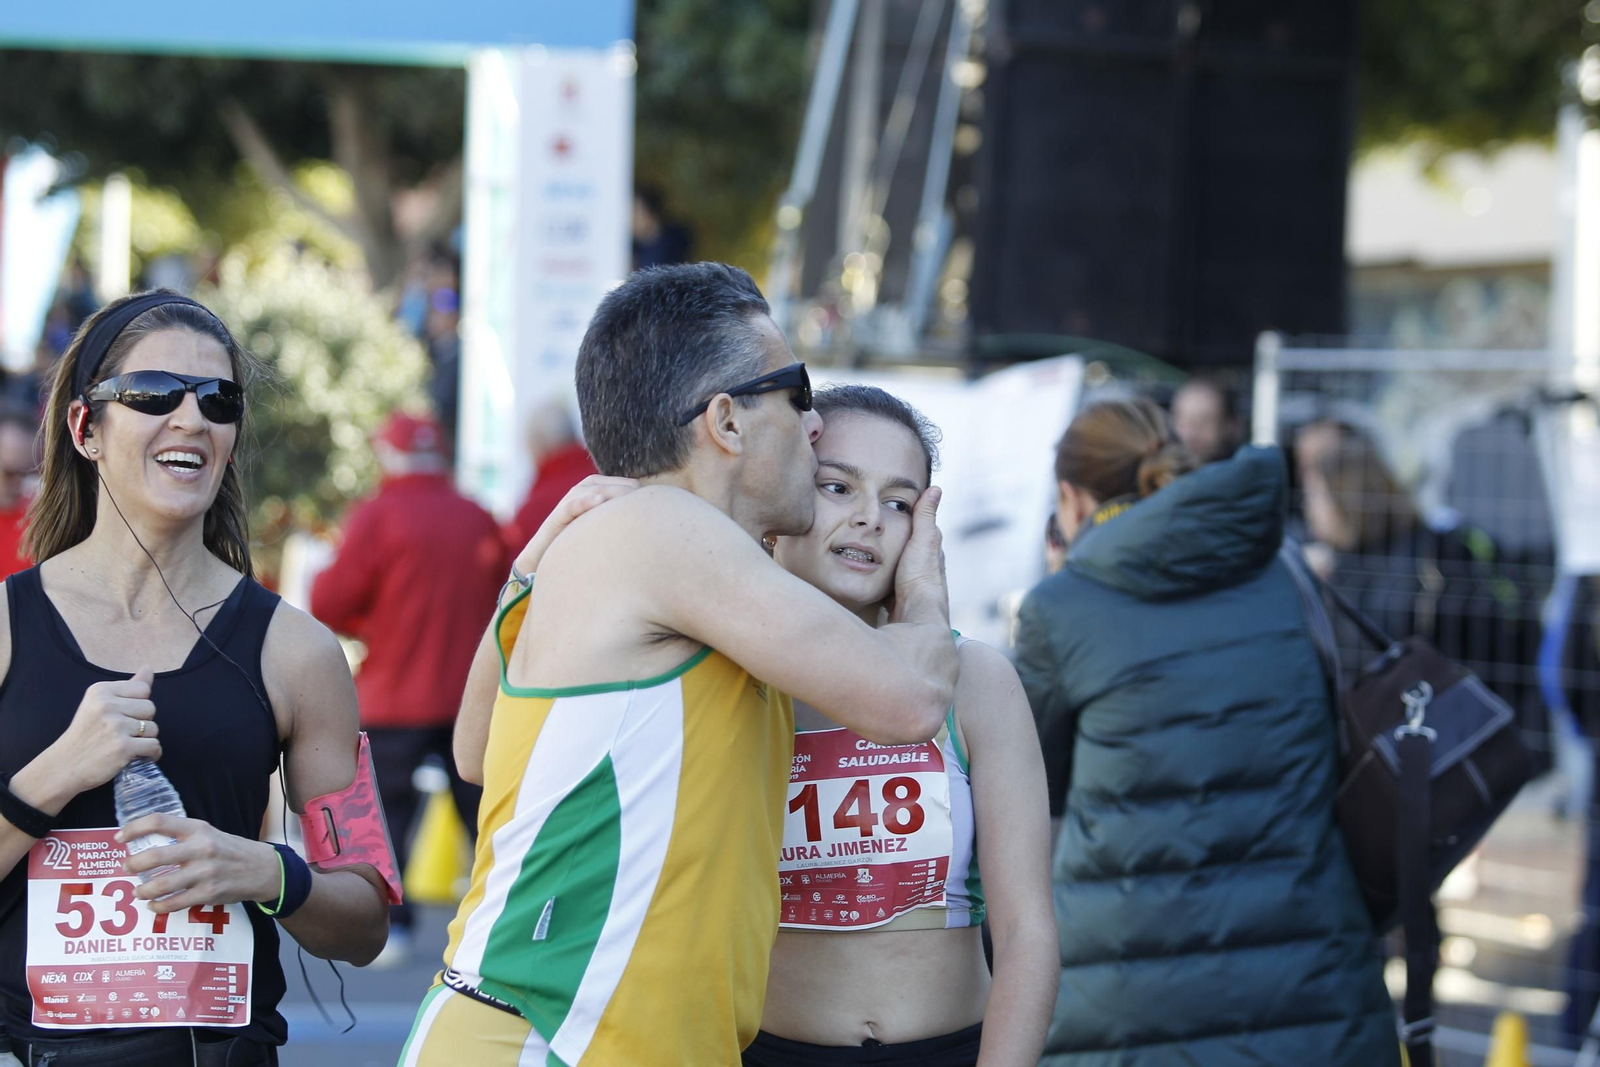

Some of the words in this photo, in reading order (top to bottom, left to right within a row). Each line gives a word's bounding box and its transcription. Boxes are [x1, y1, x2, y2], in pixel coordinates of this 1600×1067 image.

[838, 752, 929, 768] SALUDABLE
[788, 776, 925, 842] 148
[77, 842, 109, 851] MEDIO
[780, 845, 822, 862] URA
[826, 837, 908, 858] JIMENEZ
[77, 849, 127, 860] MARATÓN
[78, 859, 122, 870] ALMERÍA
[64, 938, 127, 955] DANIEL
[132, 936, 215, 952] FOREVER
[115, 968, 147, 977] ALMERÍA
[41, 974, 67, 984] NEXA
[43, 995, 69, 1004] Blanes
